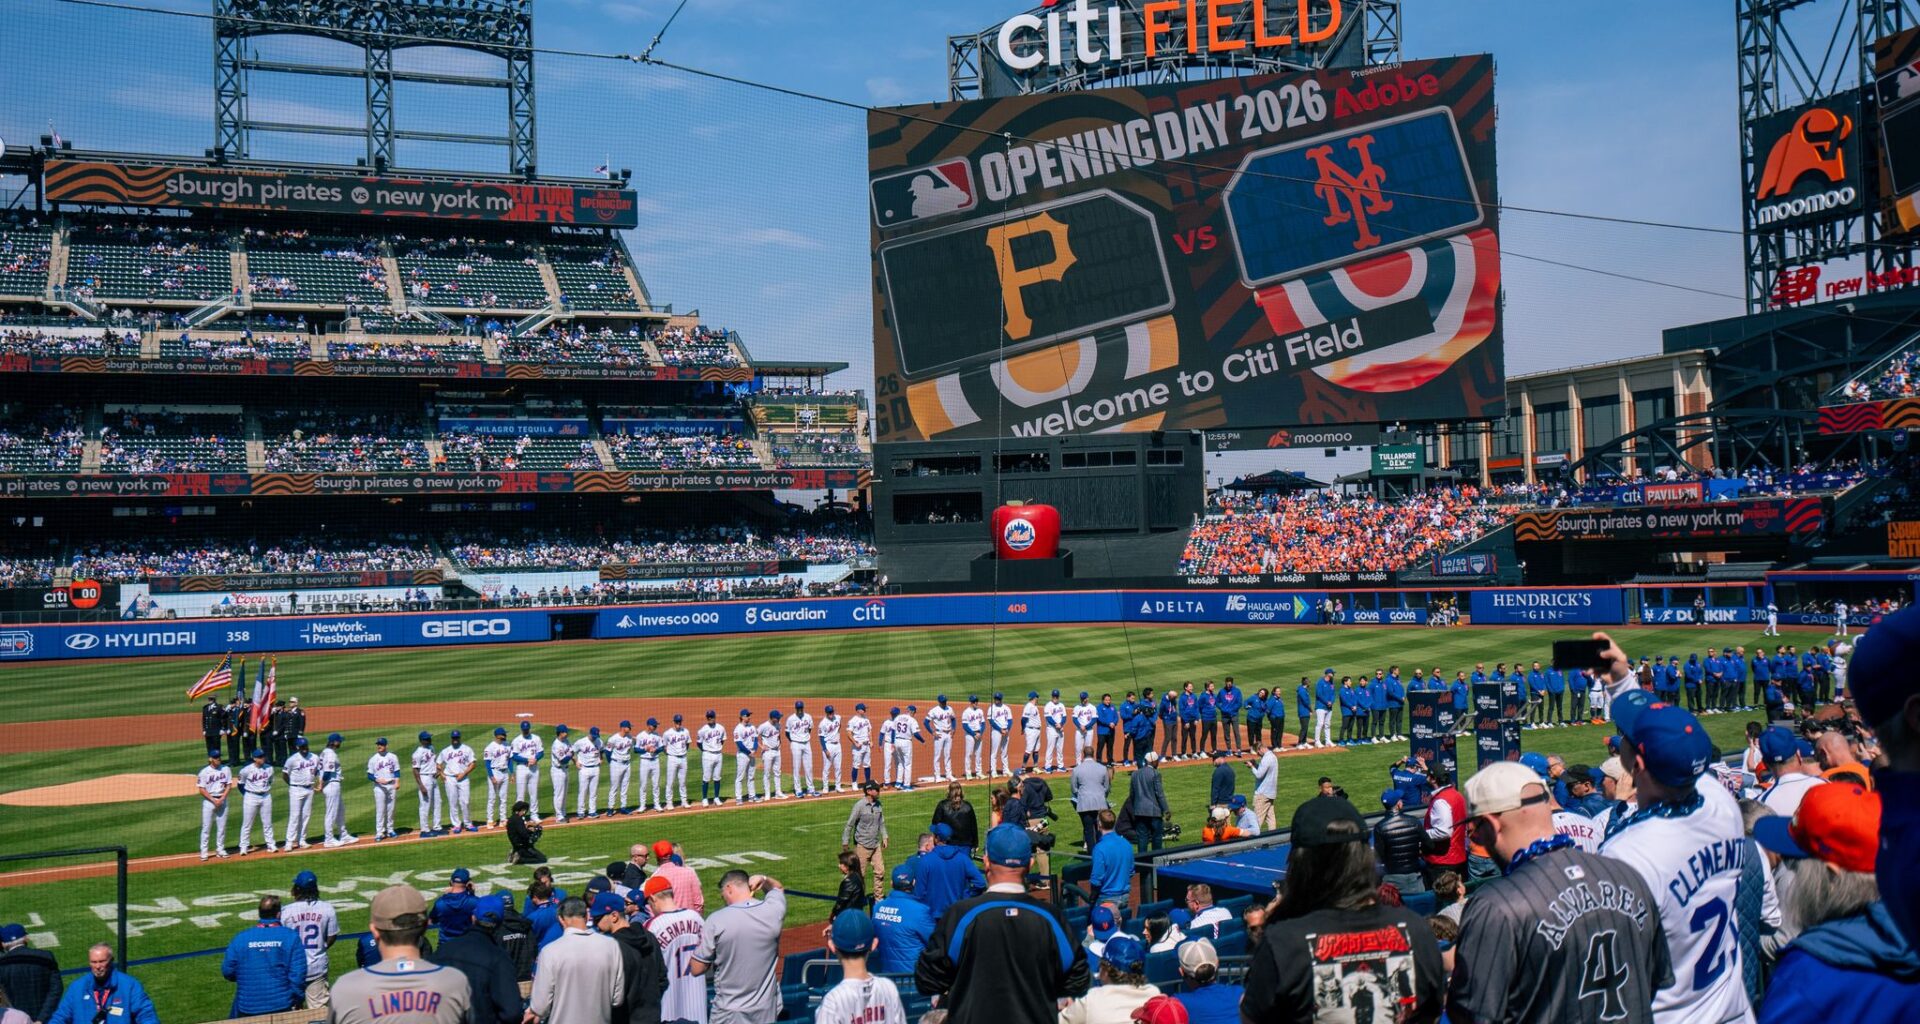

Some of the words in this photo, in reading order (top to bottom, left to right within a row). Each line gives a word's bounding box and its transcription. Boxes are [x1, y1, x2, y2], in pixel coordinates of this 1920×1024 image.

[999, 0, 1122, 70] citi
[1145, 0, 1342, 57] FIELD
[1351, 64, 1394, 79] Presented
[1393, 61, 1403, 71] by
[1334, 72, 1440, 119] Adobe
[1235, 78, 1328, 138] 2026
[166, 173, 252, 202] sburgh
[260, 179, 343, 204] pirates
[376, 190, 424, 206] new
[430, 188, 480, 212] york
[1757, 187, 1856, 225] moomoo
[985, 211, 1078, 340] P
[1825, 276, 1863, 297] new
[105, 360, 140, 371] sburgh
[141, 361, 174, 371] pirates
[186, 362, 206, 371] new
[209, 361, 229, 372] york
[334, 364, 364, 374] sburgh
[366, 365, 397, 376] pirates
[427, 365, 446, 375] york
[572, 367, 599, 377] pirates
[628, 368, 646, 378] york
[1010, 383, 1169, 438] welcome
[1177, 370, 1215, 397] to
[1222, 346, 1278, 391] Citi
[1290, 317, 1364, 366] Field
[475, 426, 515, 434] MILAGRO
[517, 426, 554, 434] TEQUILA
[1227, 432, 1241, 440] PM
[1294, 431, 1353, 444] moomoo
[1379, 452, 1417, 461] TULLAMORE
[7, 478, 60, 494] pirates
[82, 480, 113, 490] new
[117, 478, 149, 493] york
[314, 477, 360, 490] sburgh
[365, 477, 409, 490] pirates
[427, 478, 453, 488] new
[457, 477, 484, 490] york
[627, 474, 669, 488] sburgh
[671, 474, 711, 488] pirates
[727, 476, 750, 485] new
[754, 475, 779, 488] york
[1556, 510, 1599, 534] sburgh
[1600, 511, 1642, 534] pirates
[1660, 513, 1687, 527] new
[1690, 507, 1724, 530] york
[657, 565, 685, 576] pirates
[715, 566, 733, 575] york
[260, 575, 293, 586] pirates
[306, 577, 327, 585] new
[328, 575, 348, 586] york
[1188, 576, 1219, 585] HubSpot
[1228, 575, 1260, 584] HubSpot
[1274, 574, 1306, 583] HubSpot
[1357, 572, 1387, 582] HubSpot
[44, 591, 68, 602] citi
[82, 588, 97, 599] 00
[235, 592, 269, 606] Coors
[307, 594, 339, 603] FIESTA
[1493, 593, 1592, 607] HENDRICK'S
[852, 605, 886, 621] citi
[1007, 603, 1027, 614] 408
[1156, 601, 1204, 613] DELTA
[1247, 602, 1292, 612] HAUGLAND
[639, 613, 690, 627] Invesco
[692, 611, 719, 625] QQQ
[760, 607, 827, 622] Guardian
[1247, 611, 1275, 621] GROUP
[1353, 611, 1380, 621] GOYA
[1389, 611, 1417, 621] GOYA
[1529, 610, 1557, 619] GIN
[1751, 609, 1767, 620] 370
[312, 621, 367, 634] NewYork-
[421, 618, 510, 638] GEICO
[105, 631, 196, 648] HYUNDAI
[226, 631, 250, 643] 358
[312, 632, 382, 646] Presbyterian
[897, 723, 908, 734] 63
[878, 905, 900, 915] GUEST
[1536, 881, 1649, 951] ALVAREZ
[291, 911, 323, 924] LINDOR
[874, 912, 903, 923] SERVICES
[502, 933, 527, 942] SECURITY
[248, 940, 283, 948] SECURITY
[675, 944, 698, 979] 17
[1578, 929, 1630, 1021] 4
[367, 990, 442, 1019] LINDOR
